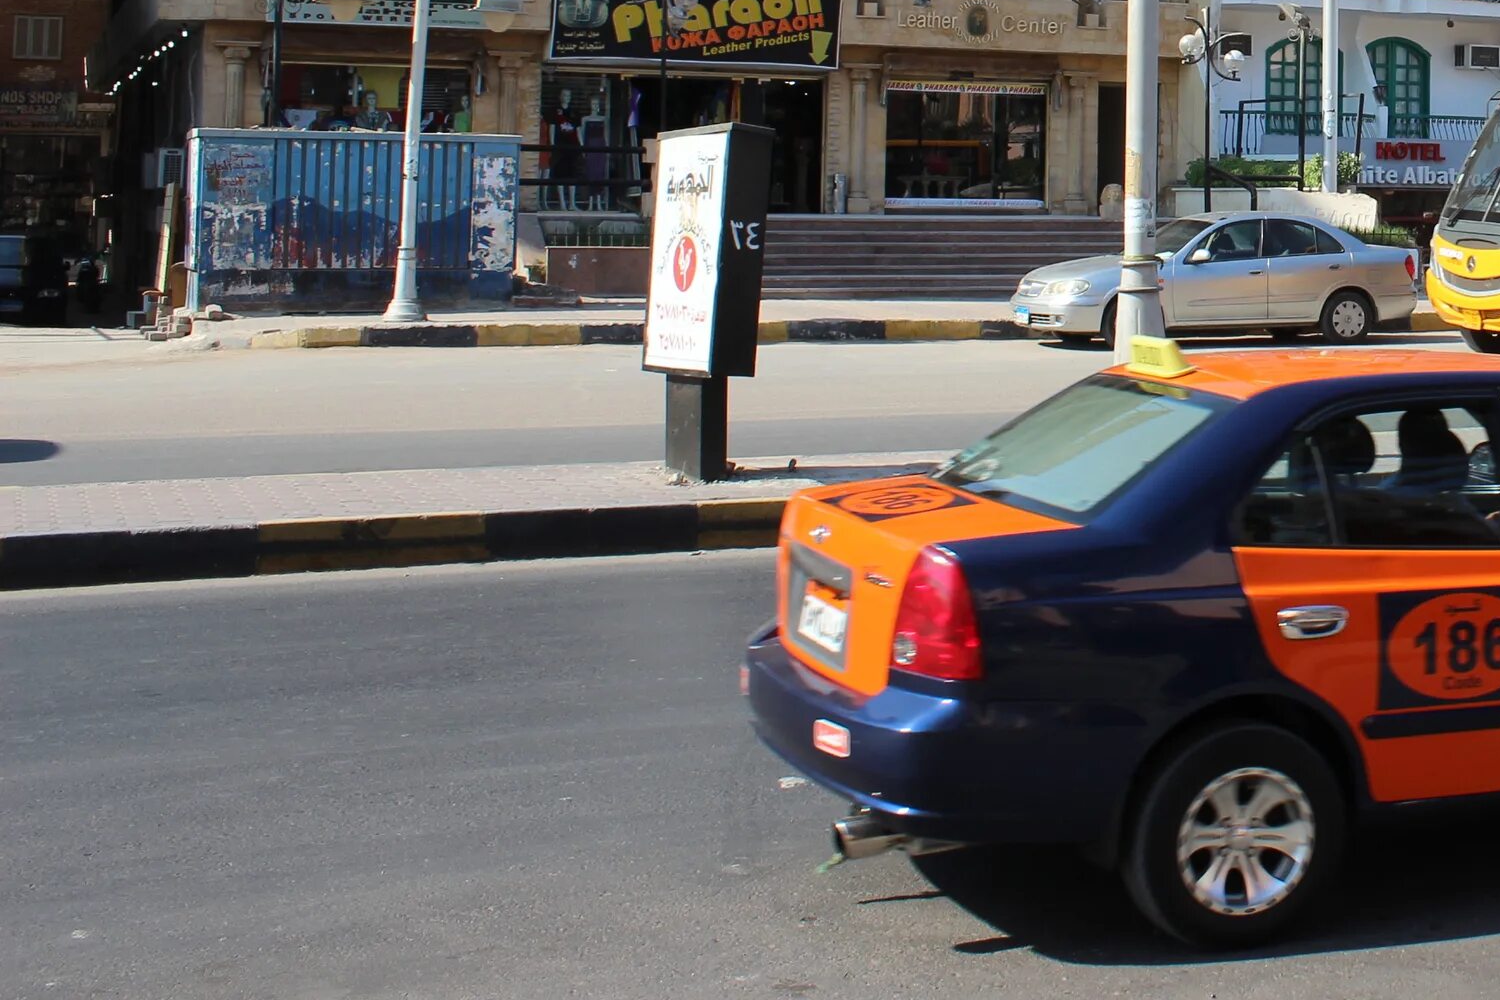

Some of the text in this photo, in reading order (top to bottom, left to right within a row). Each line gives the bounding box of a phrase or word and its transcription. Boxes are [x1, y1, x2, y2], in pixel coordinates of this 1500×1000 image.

[727, 13, 825, 41] ФАРАОН
[897, 10, 1067, 34] Leather Center
[702, 30, 810, 56] Leather Products
[29, 91, 62, 105] SHOP
[924, 83, 960, 92] PHARAON
[966, 85, 1000, 93] PHARAON
[1008, 86, 1042, 94] PHARAON
[1375, 141, 1446, 163] HOTEL
[666, 164, 714, 203] الجمهورية
